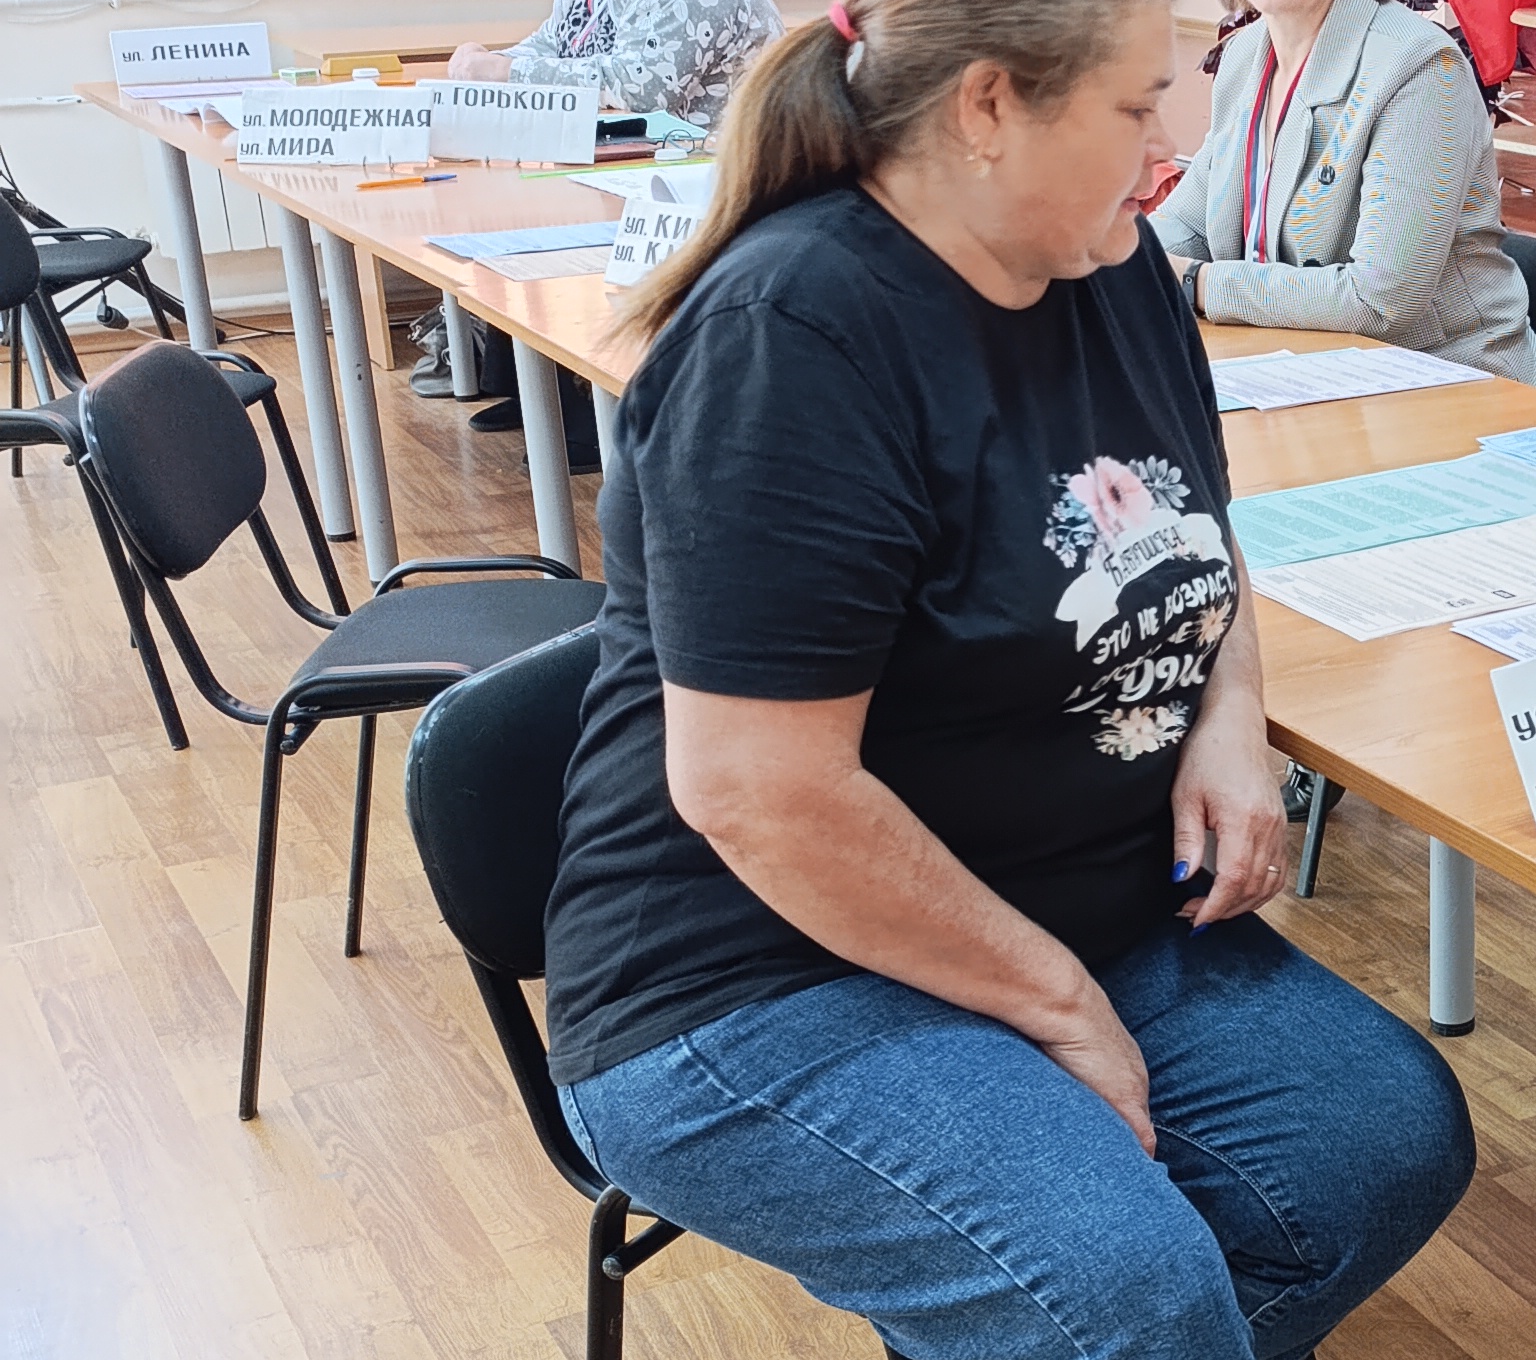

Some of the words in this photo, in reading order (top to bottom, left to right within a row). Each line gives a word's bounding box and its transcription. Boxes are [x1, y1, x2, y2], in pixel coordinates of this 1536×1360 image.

[122, 51, 145, 62] ул.
[151, 42, 251, 61] ЛЕНИНА
[452, 87, 577, 111] ГОРЬКОГО
[242, 113, 266, 128] ул.
[269, 107, 432, 132] МОЛОДЕЖНАЯ
[240, 142, 263, 156] ул.
[267, 137, 335, 156] МИРА
[624, 216, 647, 236] ул.
[614, 244, 636, 263] ул.
[1092, 620, 1132, 665] ЭТО
[1137, 606, 1160, 641] НЕ
